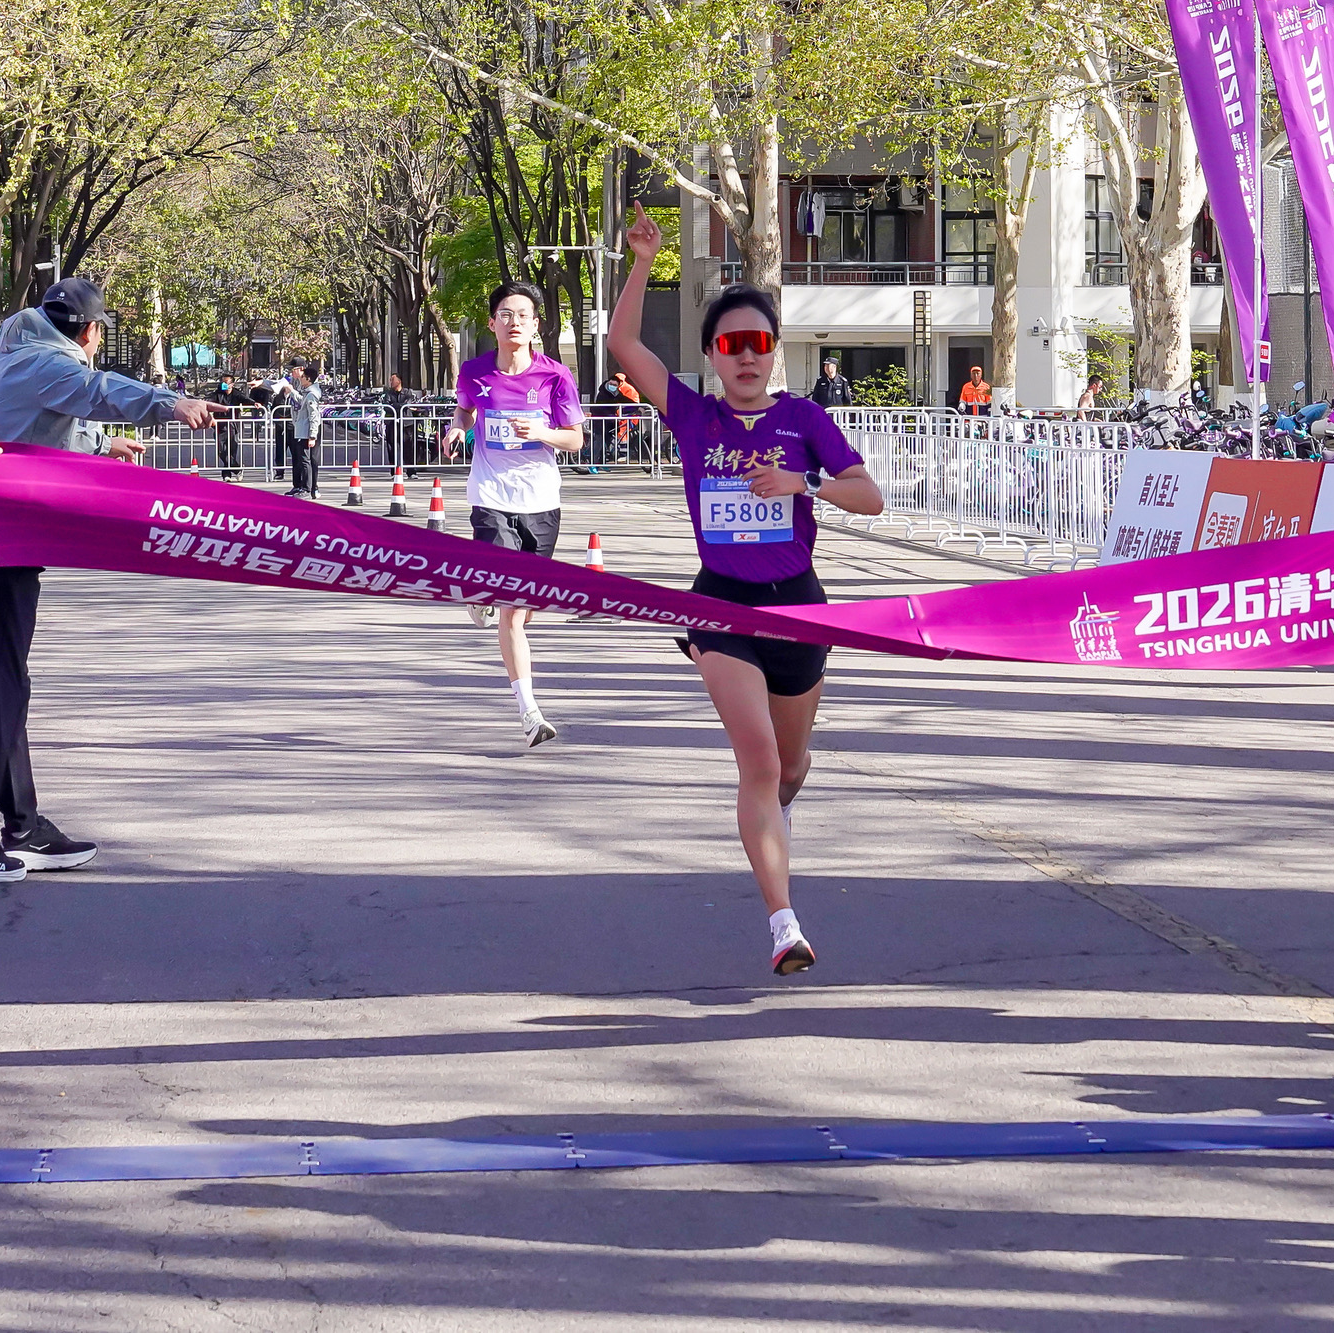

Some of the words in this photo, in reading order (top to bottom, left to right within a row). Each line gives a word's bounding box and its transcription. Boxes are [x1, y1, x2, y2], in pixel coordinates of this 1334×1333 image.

[490, 425, 516, 437] M3
[704, 443, 787, 472] 清华大学
[150, 500, 309, 546] MARATHON
[710, 502, 784, 523] F5808
[316, 534, 428, 571] CAMPUS
[434, 562, 589, 604] UNIVERSITY
[601, 597, 732, 632] TSINGHUA
[1139, 628, 1271, 660] TSINGHUA
